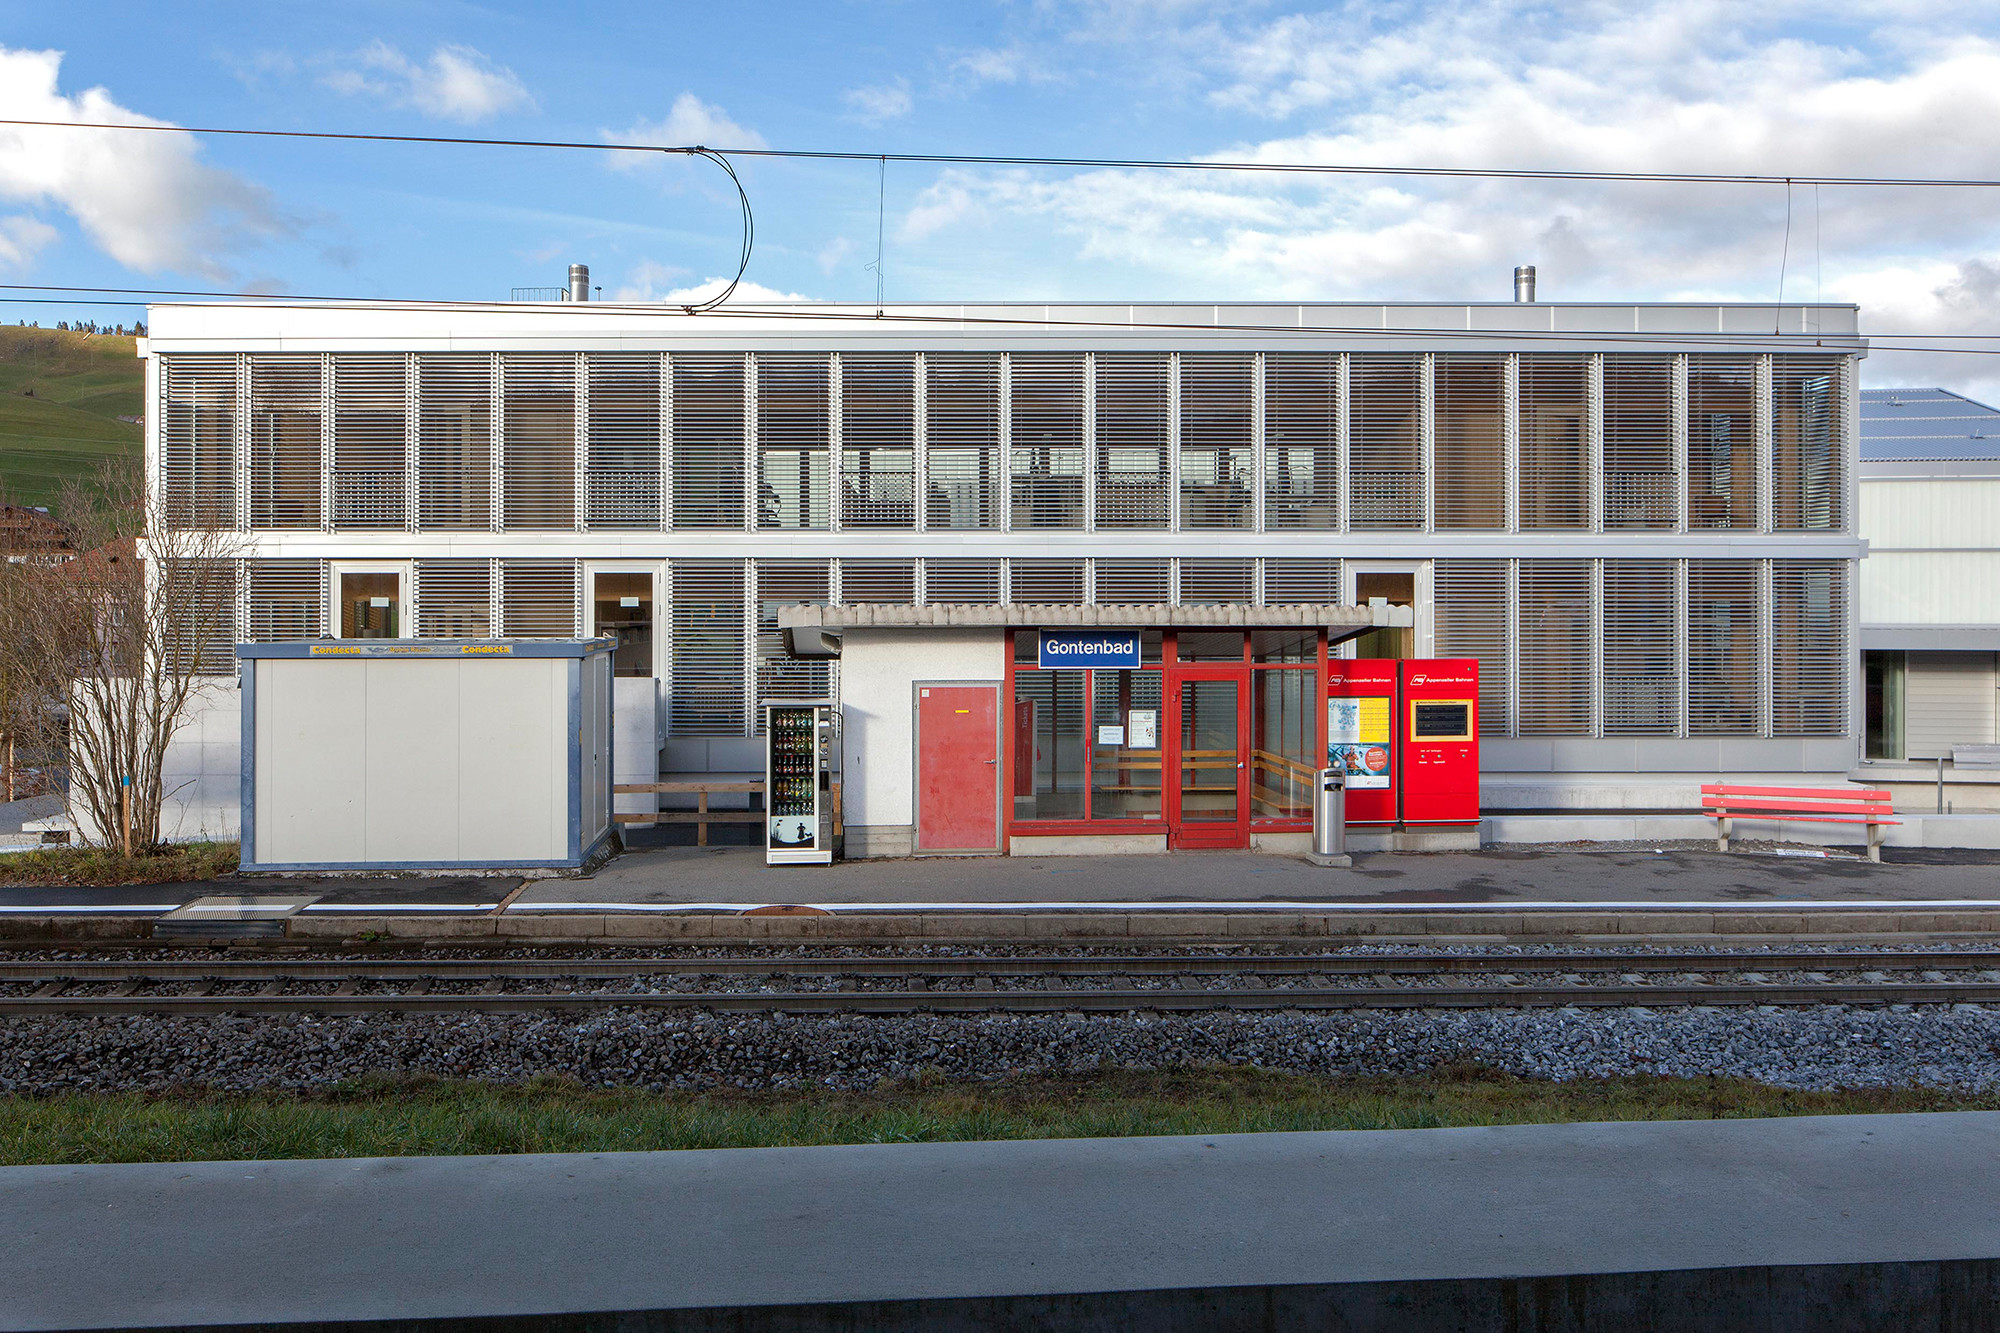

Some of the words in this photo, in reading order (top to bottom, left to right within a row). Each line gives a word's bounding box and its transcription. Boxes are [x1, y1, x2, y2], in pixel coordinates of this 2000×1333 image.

[312, 645, 361, 655] Condecta
[461, 645, 510, 654] Condecta
[1046, 639, 1133, 654] Gontenbad
